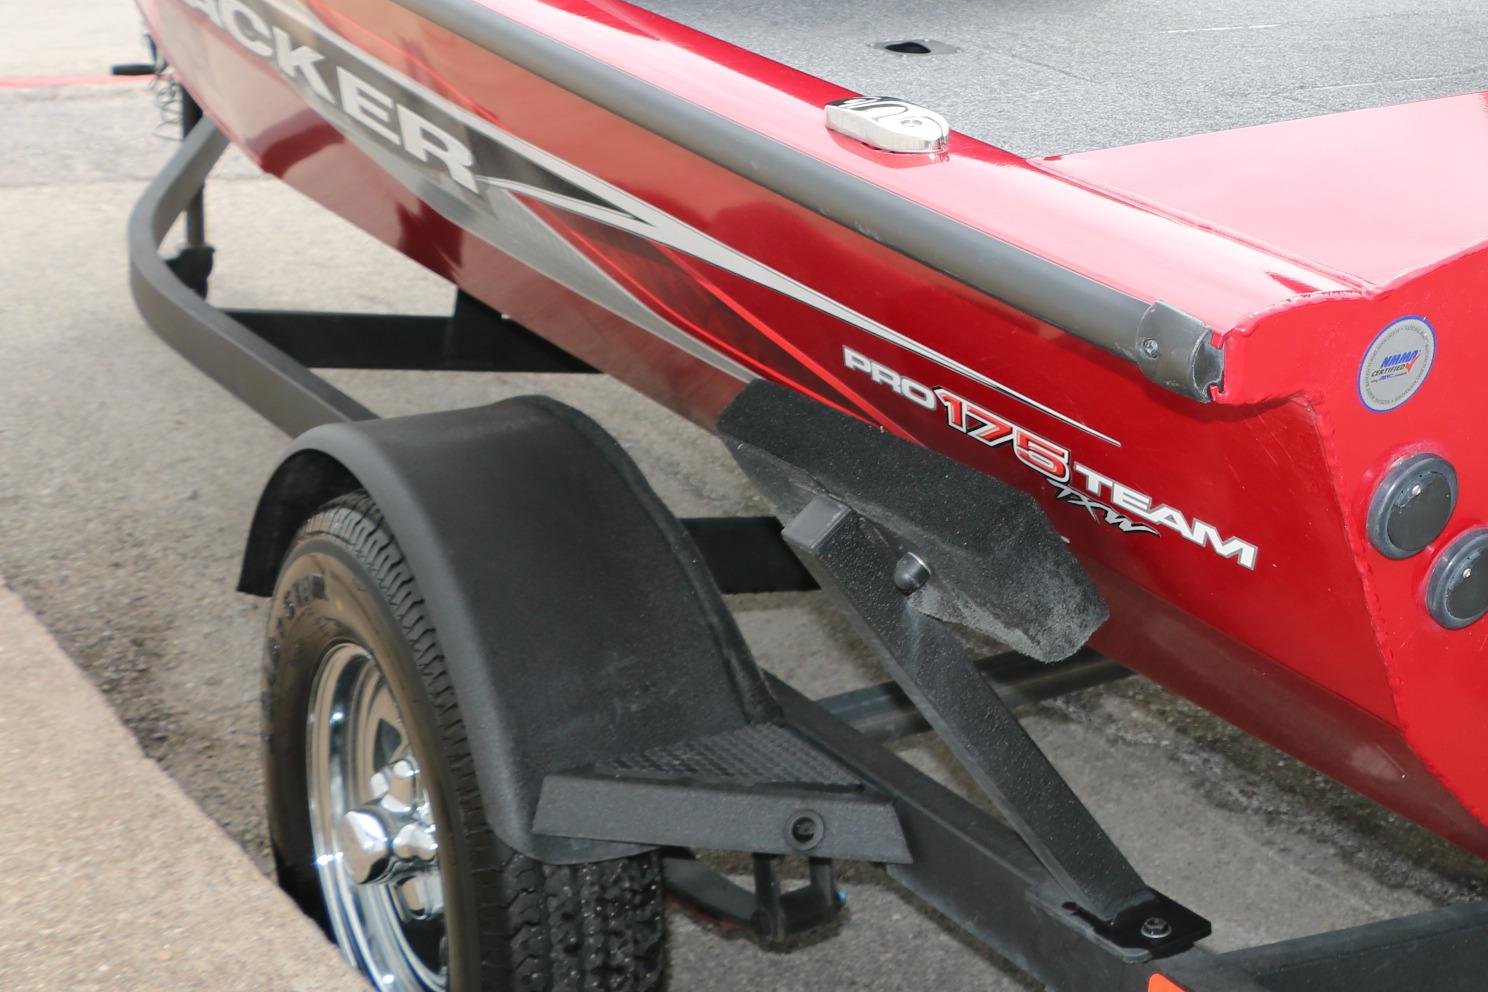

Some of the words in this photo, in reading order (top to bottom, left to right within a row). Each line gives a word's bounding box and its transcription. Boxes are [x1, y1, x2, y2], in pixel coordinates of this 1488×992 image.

[1371, 363, 1406, 378] CERTIFIED
[842, 344, 937, 411] PRO
[933, 385, 1072, 486] 175
[1073, 461, 1258, 571] TEAM
[1047, 478, 1161, 538] TXW
